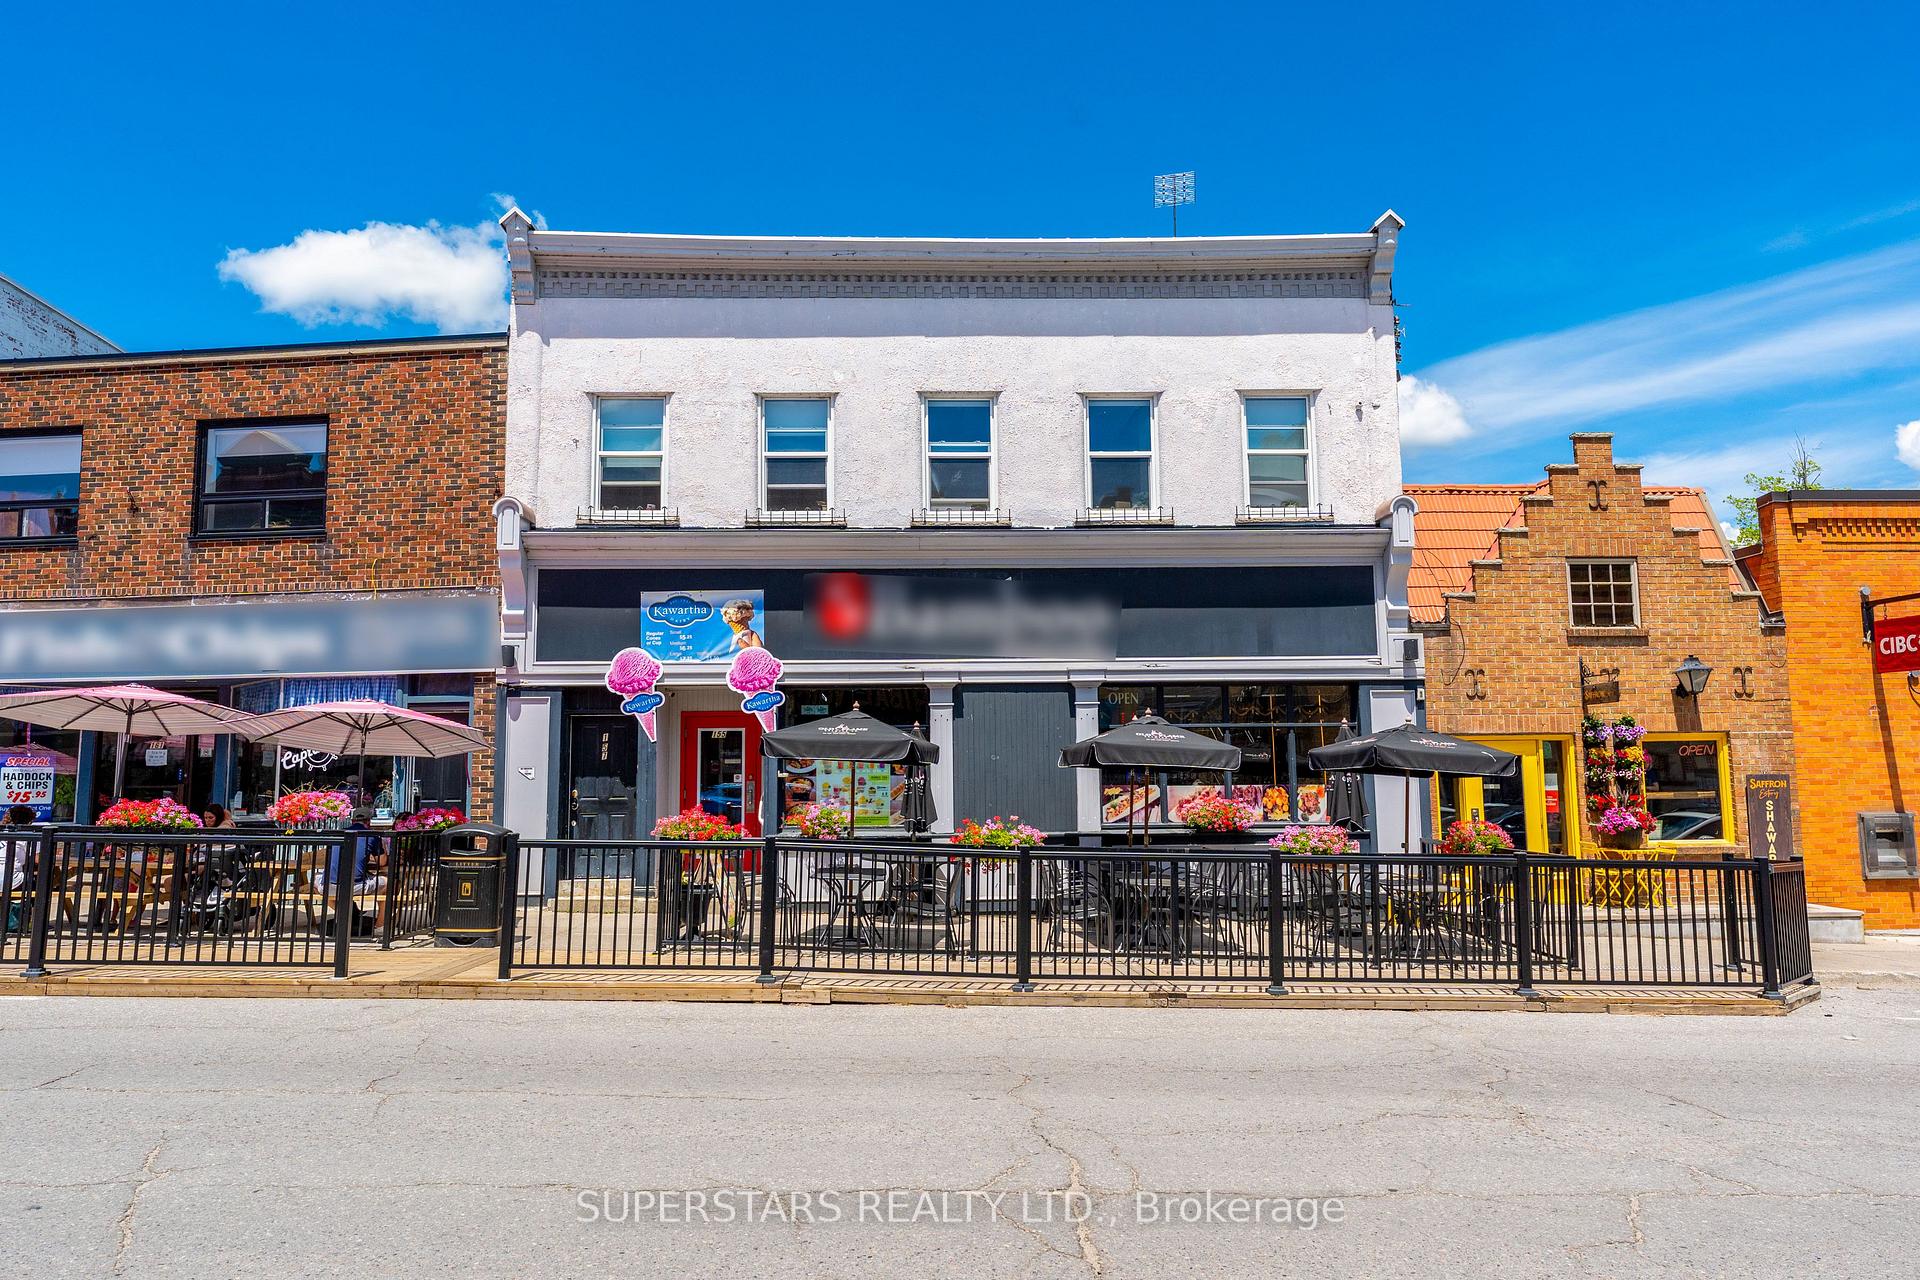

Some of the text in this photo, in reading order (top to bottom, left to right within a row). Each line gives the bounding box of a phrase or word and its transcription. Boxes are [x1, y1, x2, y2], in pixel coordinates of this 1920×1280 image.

[654, 604, 707, 617] Kawartha
[1880, 634, 1918, 655] CIBC
[626, 697, 660, 711] Kawartha
[746, 695, 780, 710] Kawartha
[1108, 692, 1139, 705] OPEN
[1679, 744, 1714, 756] OPEN
[5, 757, 50, 767] SPECIAL
[3, 773, 52, 781] HADDOCK
[1749, 778, 1787, 789] SAFFRON
[6, 781, 49, 790] & CHIPS
[7, 790, 47, 804] $15.95
